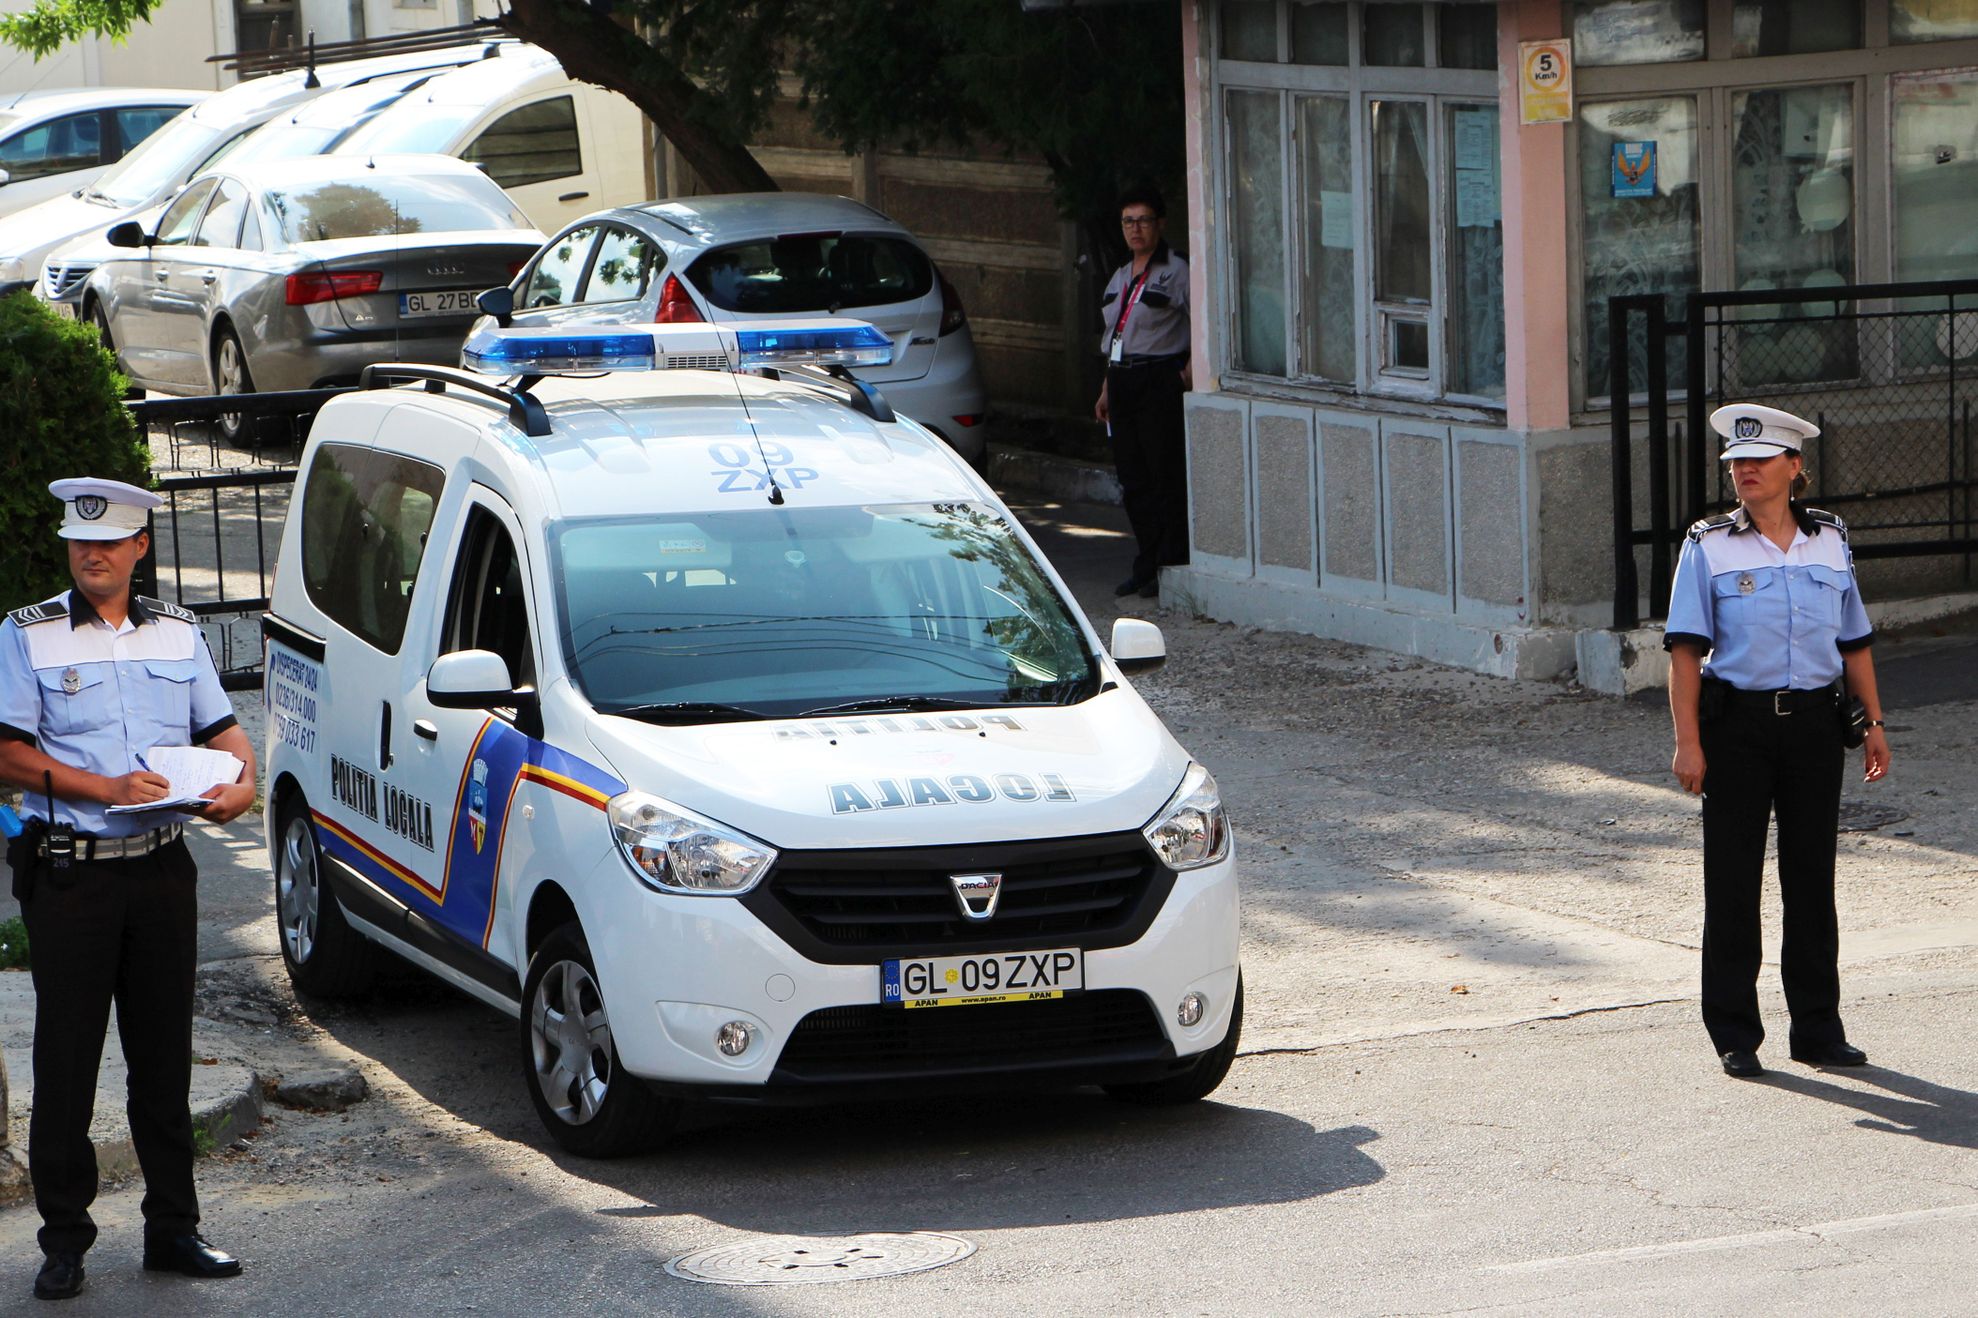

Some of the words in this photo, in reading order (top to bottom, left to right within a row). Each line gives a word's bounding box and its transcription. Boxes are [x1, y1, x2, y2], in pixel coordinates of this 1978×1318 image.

[1540, 54, 1553, 71] 5
[1535, 71, 1558, 80] Km/h
[408, 295, 431, 312] GL
[436, 293, 456, 310] 27
[708, 440, 795, 468] 09
[711, 467, 820, 493] ZXP
[300, 726, 316, 754] 617
[331, 753, 379, 824] POLITIA
[383, 781, 435, 853] LOCALA
[960, 881, 995, 890] DACIA
[904, 962, 948, 994] GL
[961, 958, 1000, 992] 09
[1004, 952, 1076, 989] ZXP
[885, 983, 900, 997] RO
[914, 998, 939, 1008] APAN
[960, 994, 1007, 1004] www.apan.ro
[1028, 991, 1053, 1000] APAN
